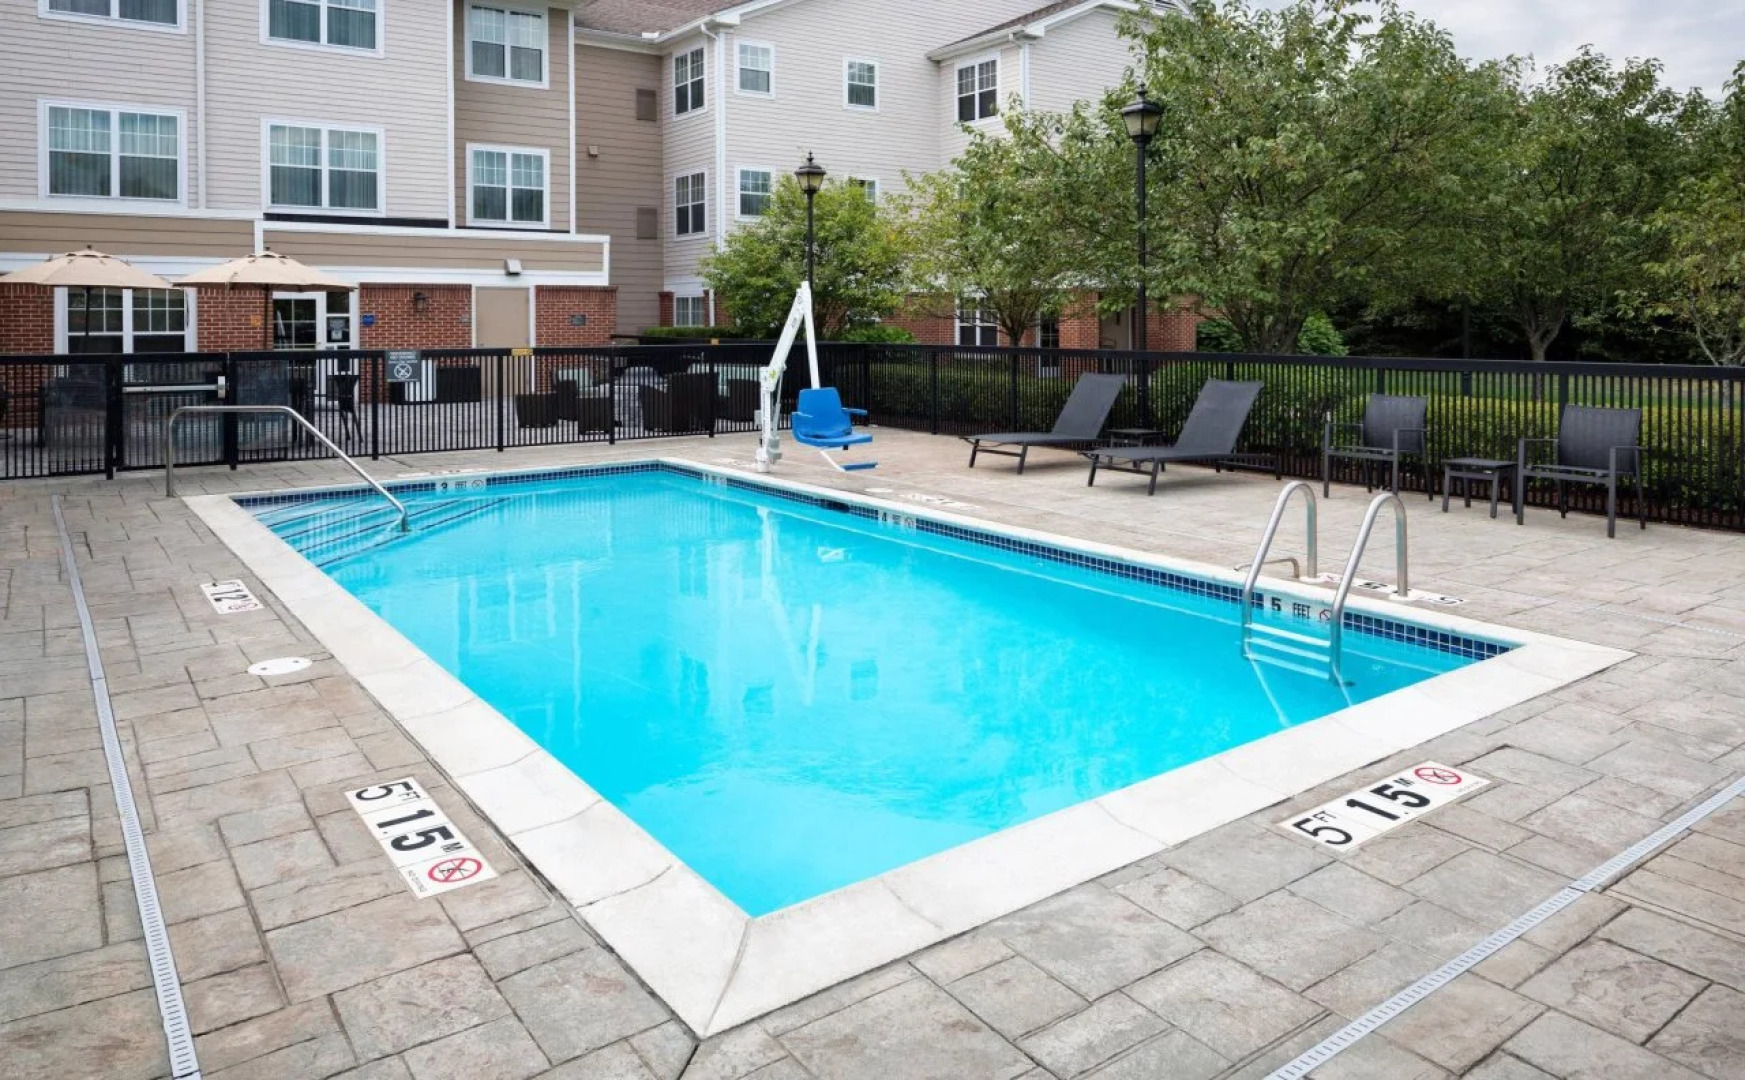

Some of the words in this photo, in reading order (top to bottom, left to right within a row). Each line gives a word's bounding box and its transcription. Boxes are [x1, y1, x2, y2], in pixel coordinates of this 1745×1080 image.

[1270, 597, 1282, 612] 5
[1293, 602, 1311, 620] FEET
[355, 781, 414, 801] 5
[1312, 810, 1337, 823] FT
[1292, 817, 1353, 846] 5
